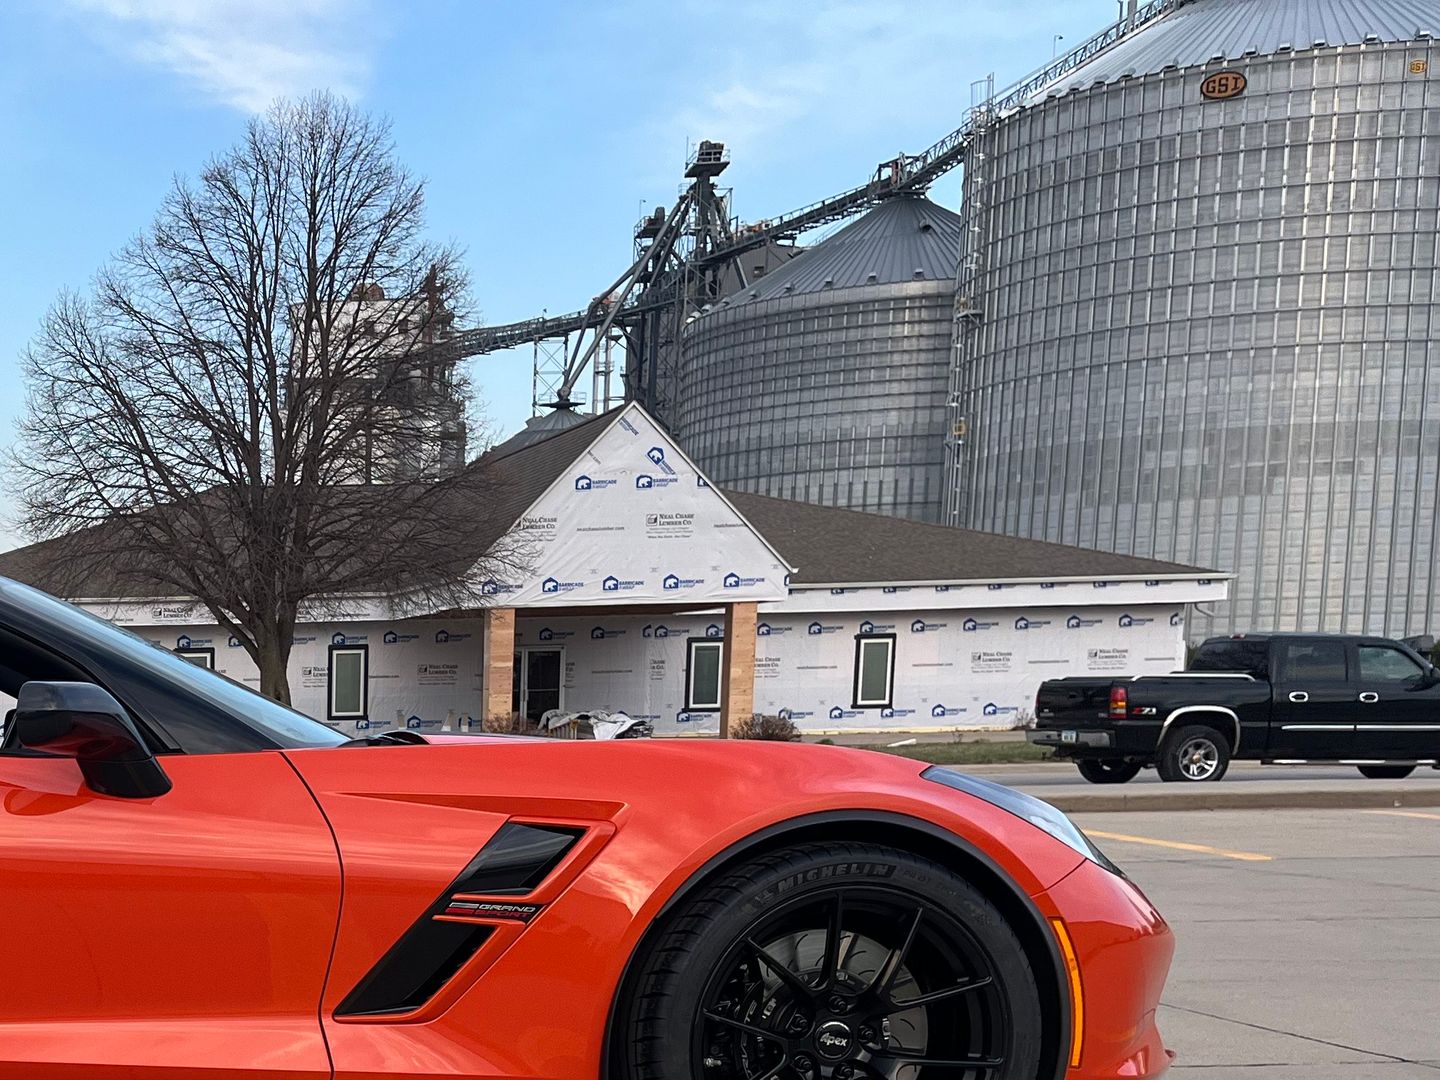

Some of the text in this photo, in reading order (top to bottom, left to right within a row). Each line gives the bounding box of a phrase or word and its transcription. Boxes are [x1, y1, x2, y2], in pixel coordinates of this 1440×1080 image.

[1205, 76, 1242, 94] GSI
[1131, 707, 1157, 715] Z71
[777, 863, 892, 893] MICHELIN
[479, 904, 536, 912] GRAND
[474, 910, 531, 918] SPORT
[819, 1032, 849, 1047] Apex
